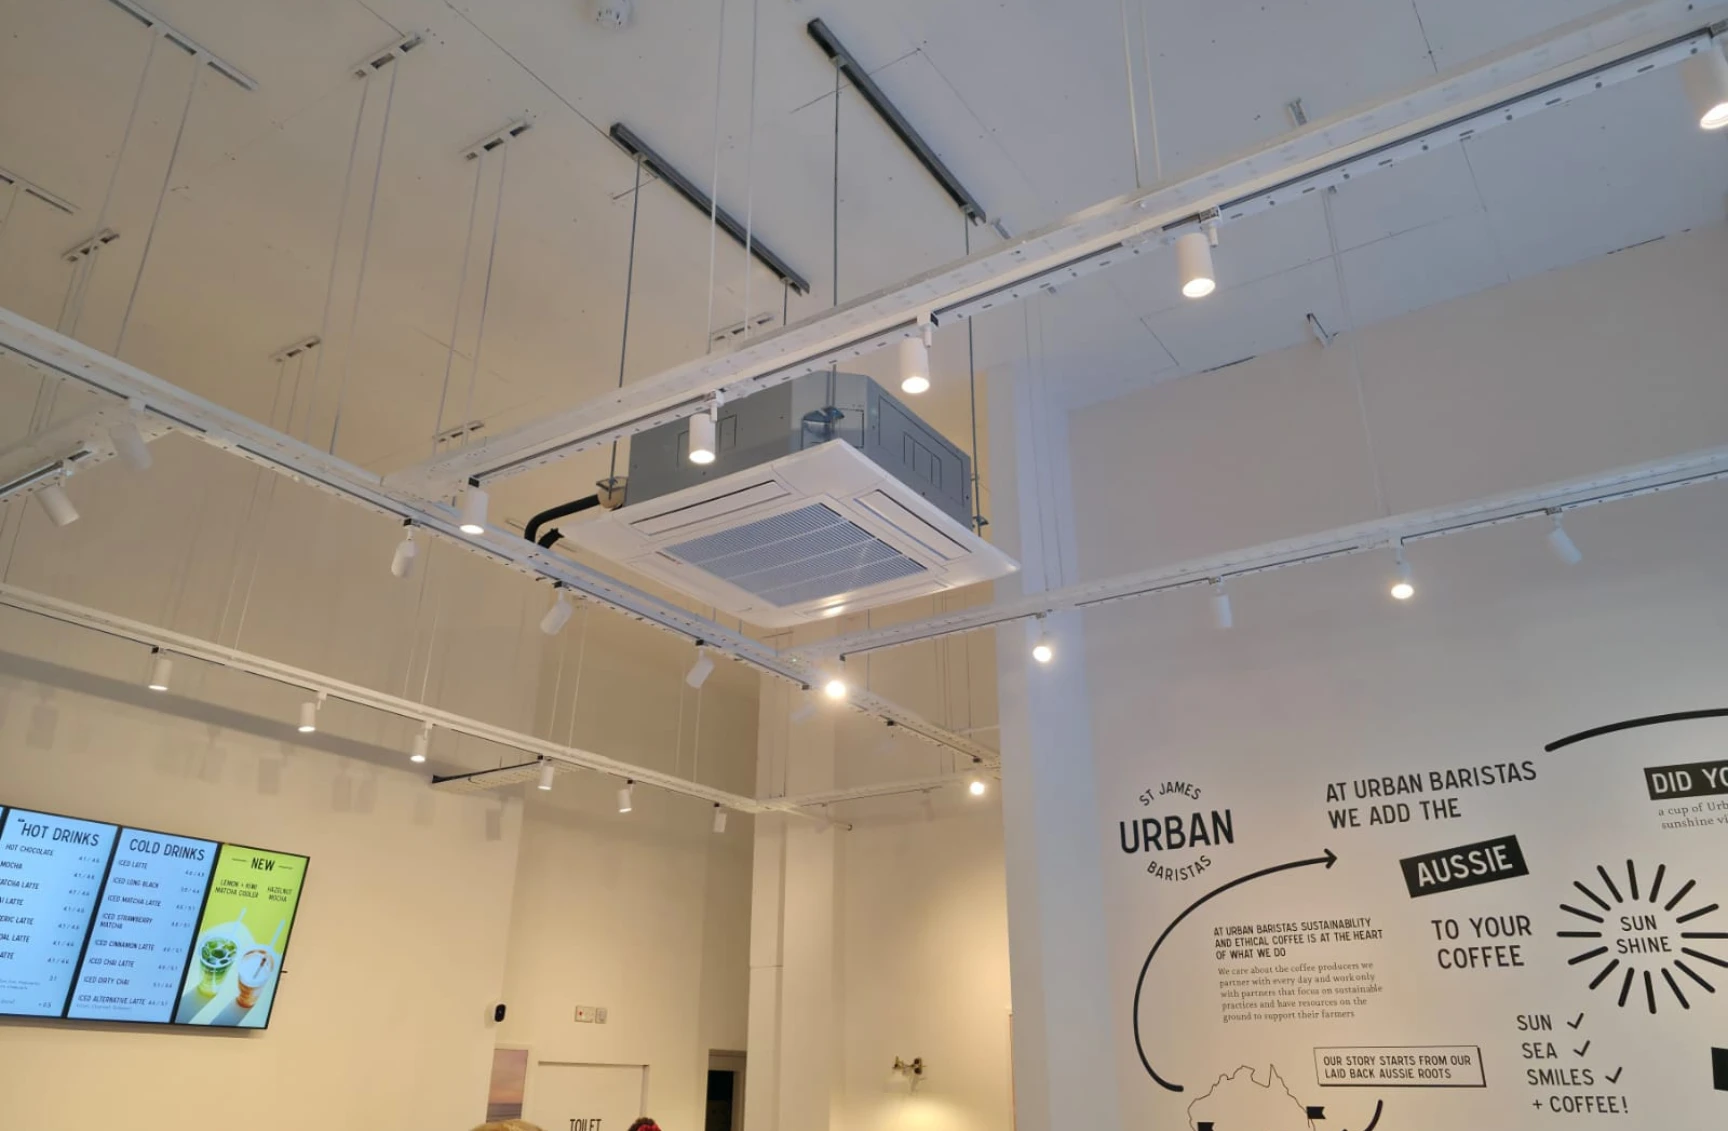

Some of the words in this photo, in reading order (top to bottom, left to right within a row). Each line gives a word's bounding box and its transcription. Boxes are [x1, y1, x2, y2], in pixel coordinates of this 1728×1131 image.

[1326, 782, 1347, 803] AT
[1354, 773, 1423, 798] URBAN
[1429, 761, 1537, 792] BARISTAS
[1652, 771, 1692, 794] DID
[1139, 788, 1155, 806] ST
[1159, 781, 1201, 800] JAMES
[1328, 808, 1361, 829] WE
[1369, 803, 1410, 826] ADD
[1419, 798, 1462, 820] THE
[1668, 807, 1689, 817] cup
[1692, 802, 1703, 812] of
[1119, 809, 1234, 854] URBAN
[1661, 817, 1715, 829] sunshine
[21, 822, 49, 839] HOT
[52, 827, 100, 847] DRINKS
[129, 838, 160, 854] COLD
[163, 843, 205, 861] DRINKS
[251, 857, 276, 871] NEW
[1147, 855, 1211, 881] BARISTAS
[1417, 844, 1513, 888] AUSSIE
[1213, 927, 1224, 936] AT
[1225, 925, 1254, 936] URBAN
[1256, 922, 1298, 934] BARISTAS
[1301, 917, 1372, 931] SUSTAINABILITY
[1431, 918, 1459, 940] TO
[1469, 915, 1532, 938] YOUR
[1620, 914, 1657, 931] SUN
[1215, 938, 1232, 948] AND
[1235, 936, 1269, 947] ETHICAL
[1272, 934, 1304, 945] COFFEE
[1307, 933, 1317, 943] IS
[1320, 932, 1331, 942] AT
[1334, 930, 1351, 942] THE
[1353, 929, 1383, 941] HEART
[1616, 936, 1672, 954] SHINE
[1216, 950, 1226, 960] OF
[1230, 949, 1254, 960] WHAT
[1257, 948, 1271, 958] WE
[1274, 947, 1286, 957] DO
[1437, 945, 1525, 969] COFFEE
[1218, 967, 1230, 975] We
[1231, 967, 1249, 975] care
[1250, 965, 1273, 974] about
[1275, 964, 1289, 973] the
[1291, 963, 1316, 972] coffee
[1318, 962, 1360, 973] producers
[1219, 979, 1250, 988] partner
[1252, 977, 1270, 985] with
[1273, 977, 1295, 987] every
[1298, 975, 1312, 986] day
[1315, 974, 1331, 983] and
[1333, 973, 1354, 982] work
[1356, 972, 1375, 983] only
[1221, 990, 1239, 998] with
[1241, 989, 1276, 1000] partners
[1278, 987, 1295, 996] that
[1298, 987, 1320, 995] focus
[1334, 984, 1383, 994] sustainable
[1222, 1000, 1258, 1012] practices
[1260, 999, 1275, 1008] and
[1276, 999, 1296, 1008] have
[1298, 999, 1338, 1007] resources
[1353, 997, 1367, 1006] the
[1223, 1012, 1252, 1023] ground
[1253, 1012, 1262, 1020] to
[1264, 1011, 1295, 1021] support
[1298, 1010, 1319, 1019] their
[1321, 1010, 1355, 1018] farmers
[1516, 1014, 1553, 1031] SUN
[1522, 1042, 1558, 1059] SEA
[1323, 1056, 1343, 1066] OUR
[1346, 1055, 1375, 1066] STORY
[1379, 1055, 1416, 1066] STARTS
[1419, 1055, 1448, 1065] FROM
[1450, 1055, 1471, 1065] OUR
[1324, 1068, 1346, 1079] LAID
[1349, 1068, 1375, 1079] BACK
[1379, 1068, 1415, 1079] AUSSIE
[1418, 1068, 1452, 1079] ROOTS
[1527, 1069, 1594, 1086] SMILES
[1550, 1096, 1629, 1114] COFFEE!
